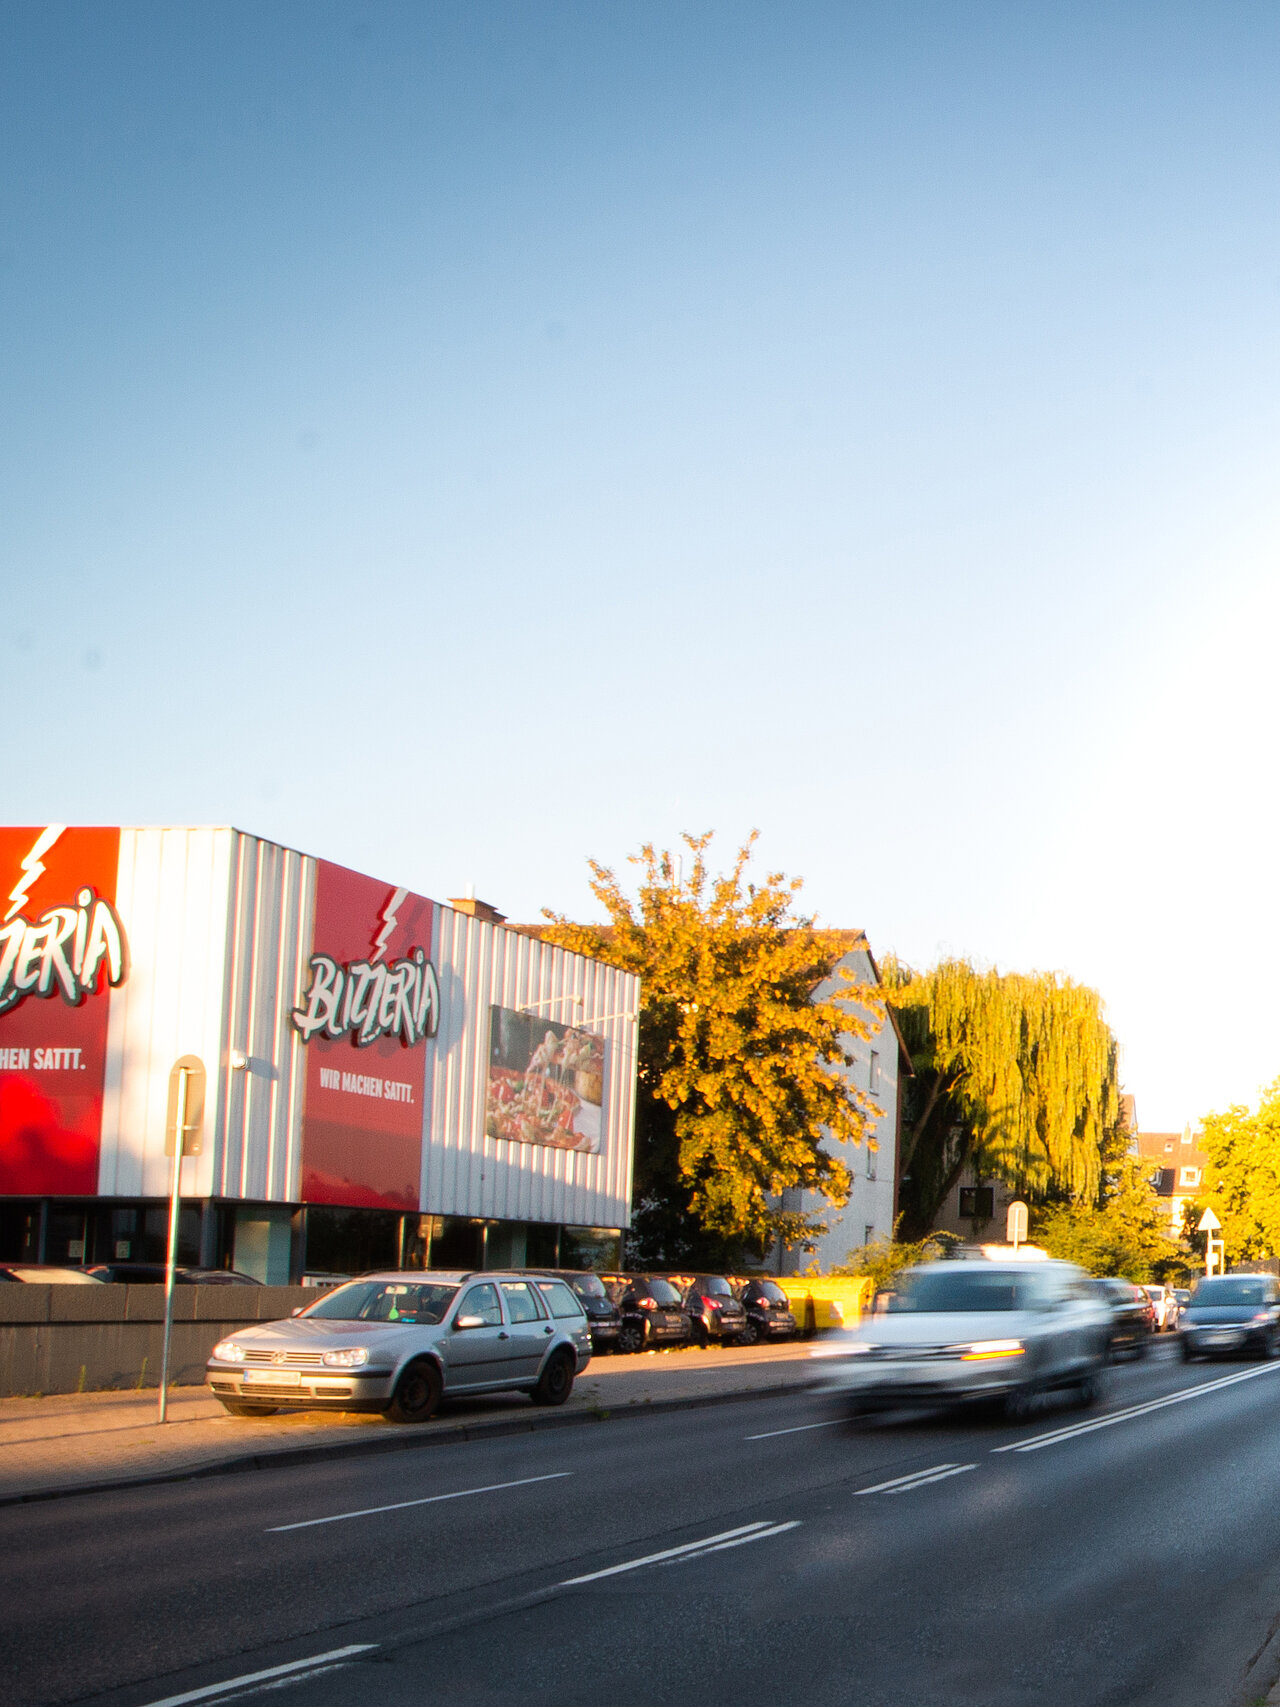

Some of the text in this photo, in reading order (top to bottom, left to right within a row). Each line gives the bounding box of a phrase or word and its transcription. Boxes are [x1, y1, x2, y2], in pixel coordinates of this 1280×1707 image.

[33, 1047, 86, 1070] SATTT.
[320, 1067, 415, 1104] WIR MACHEN SATTT.
